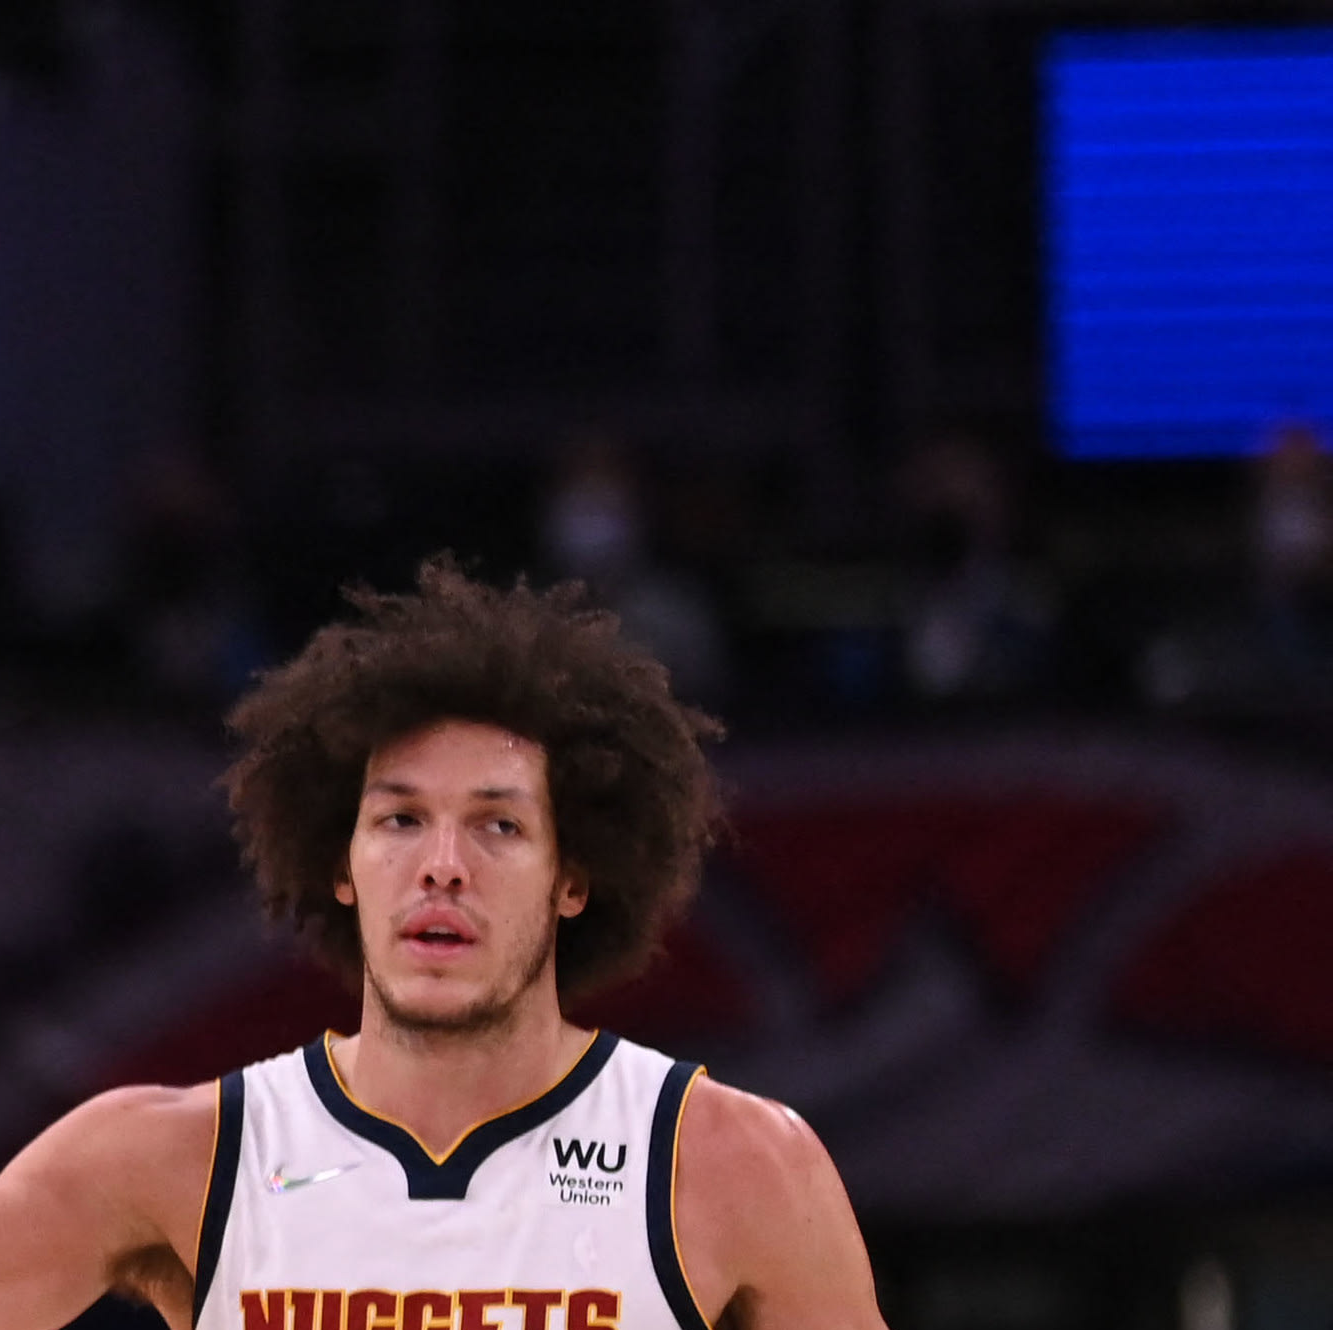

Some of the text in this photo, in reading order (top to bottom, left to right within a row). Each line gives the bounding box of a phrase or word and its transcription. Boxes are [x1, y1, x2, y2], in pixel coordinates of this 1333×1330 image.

[553, 1138, 627, 1174] WU
[549, 1172, 623, 1192] Western
[560, 1189, 610, 1206] Union
